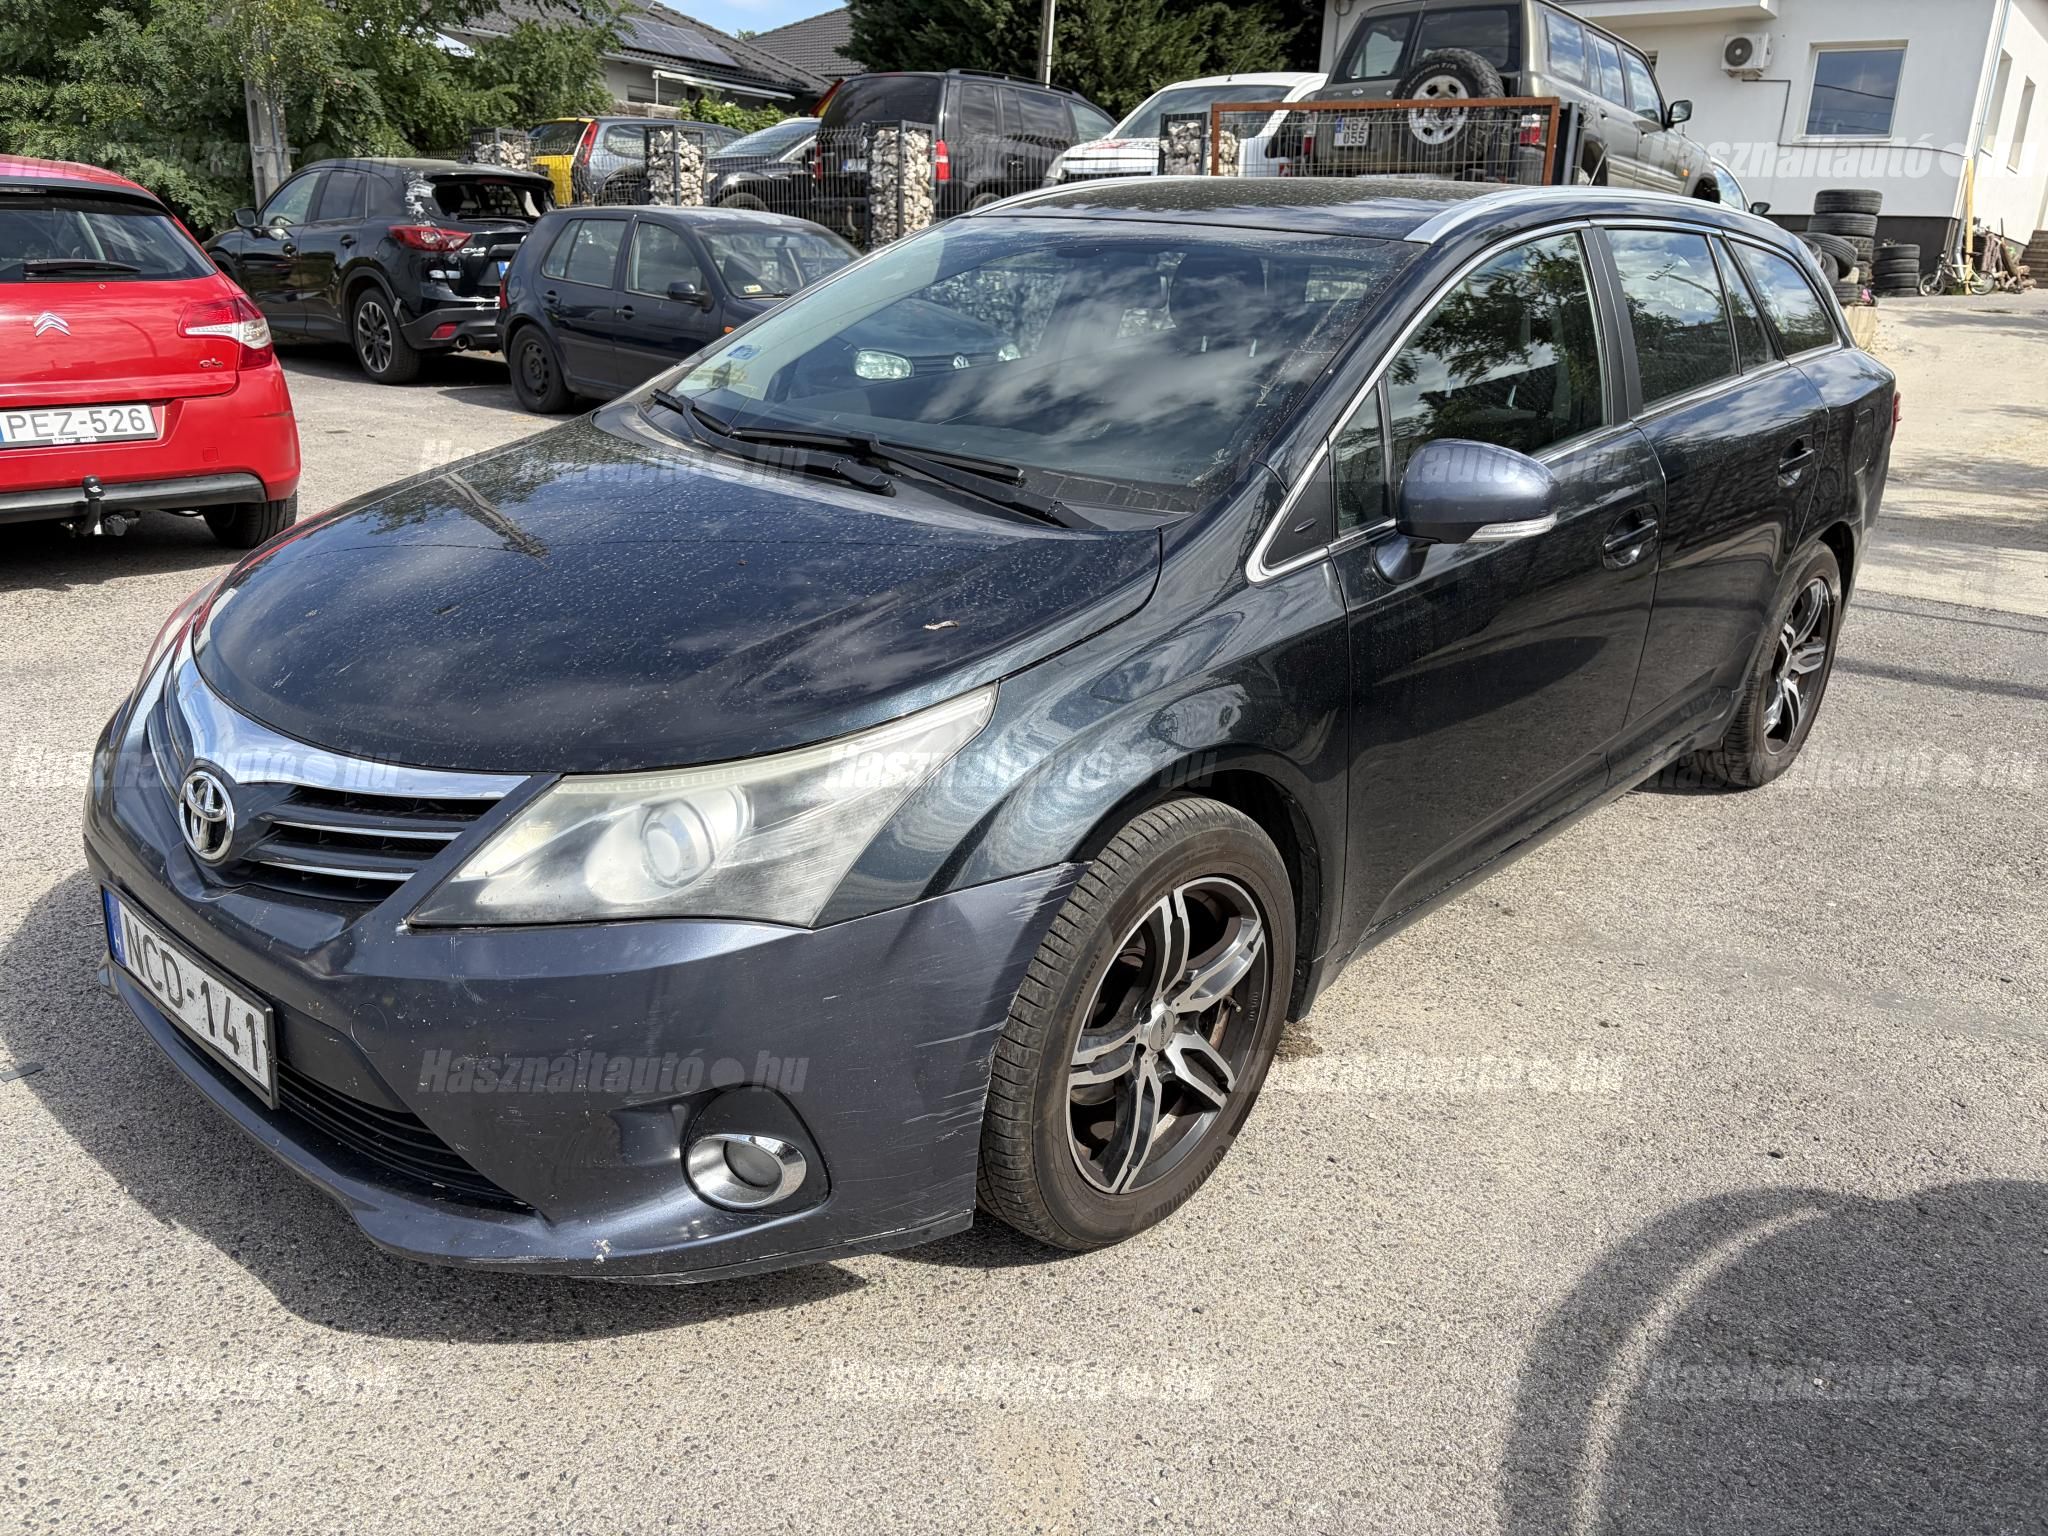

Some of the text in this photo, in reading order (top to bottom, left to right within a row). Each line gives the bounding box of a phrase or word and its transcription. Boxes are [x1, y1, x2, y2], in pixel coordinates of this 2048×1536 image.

[5, 408, 146, 439] PEZ-526
[113, 934, 122, 953] H
[123, 912, 260, 1073] NCD-141
